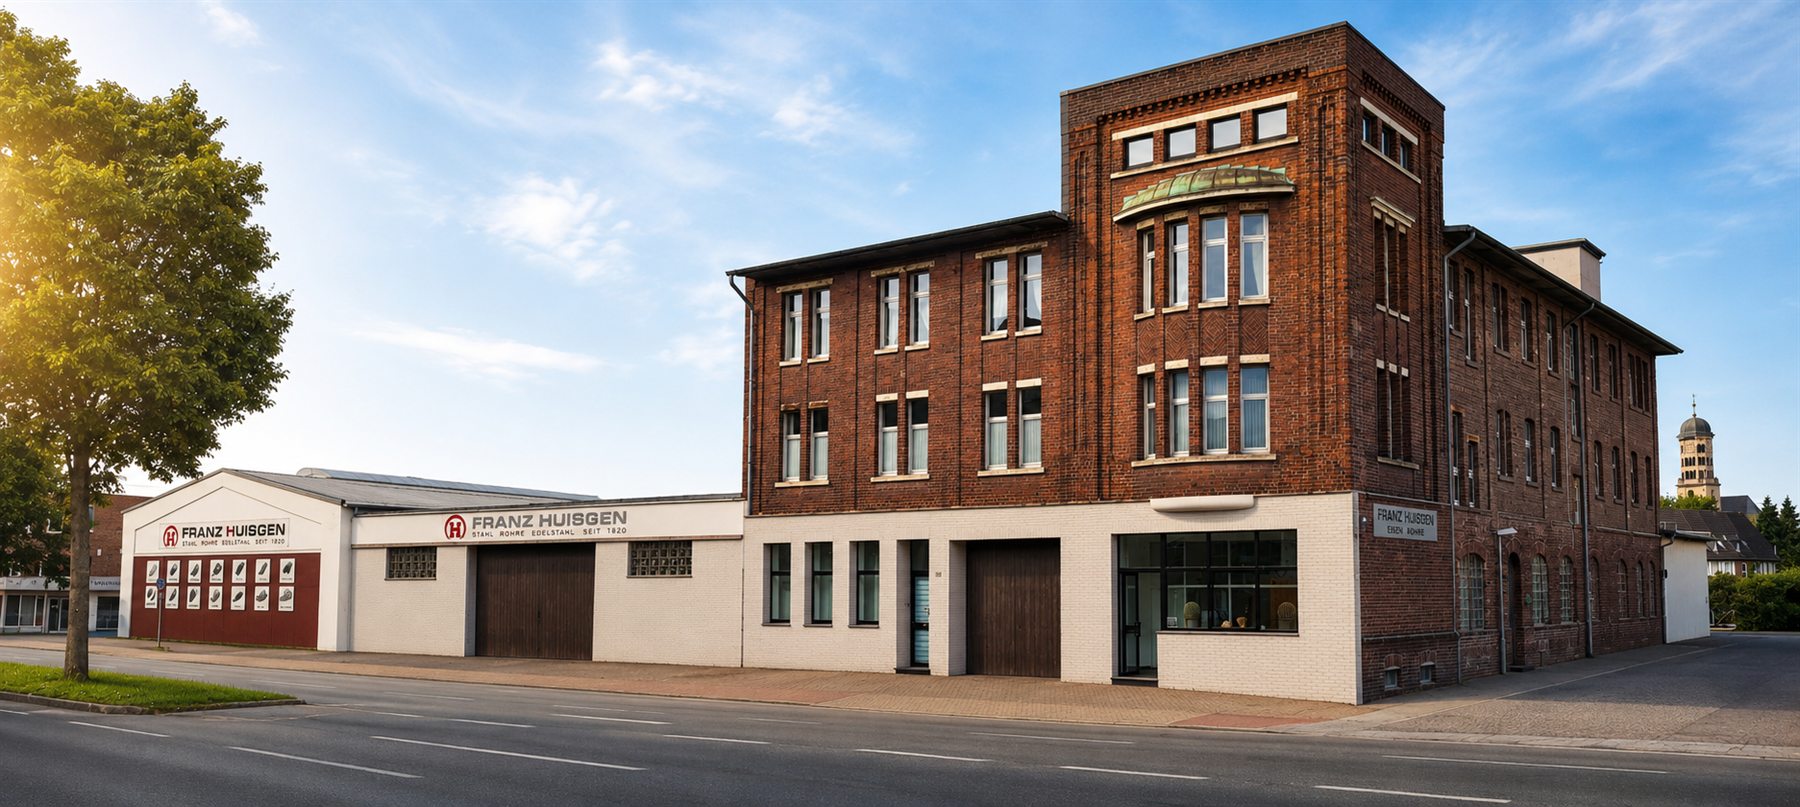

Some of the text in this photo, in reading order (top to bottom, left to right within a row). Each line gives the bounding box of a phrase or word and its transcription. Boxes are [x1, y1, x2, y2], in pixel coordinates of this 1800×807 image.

[473, 511, 627, 529] FRANZ HUISGEN
[1377, 508, 1403, 522] FRANZ
[182, 523, 286, 539] FRANZ HUISGEN
